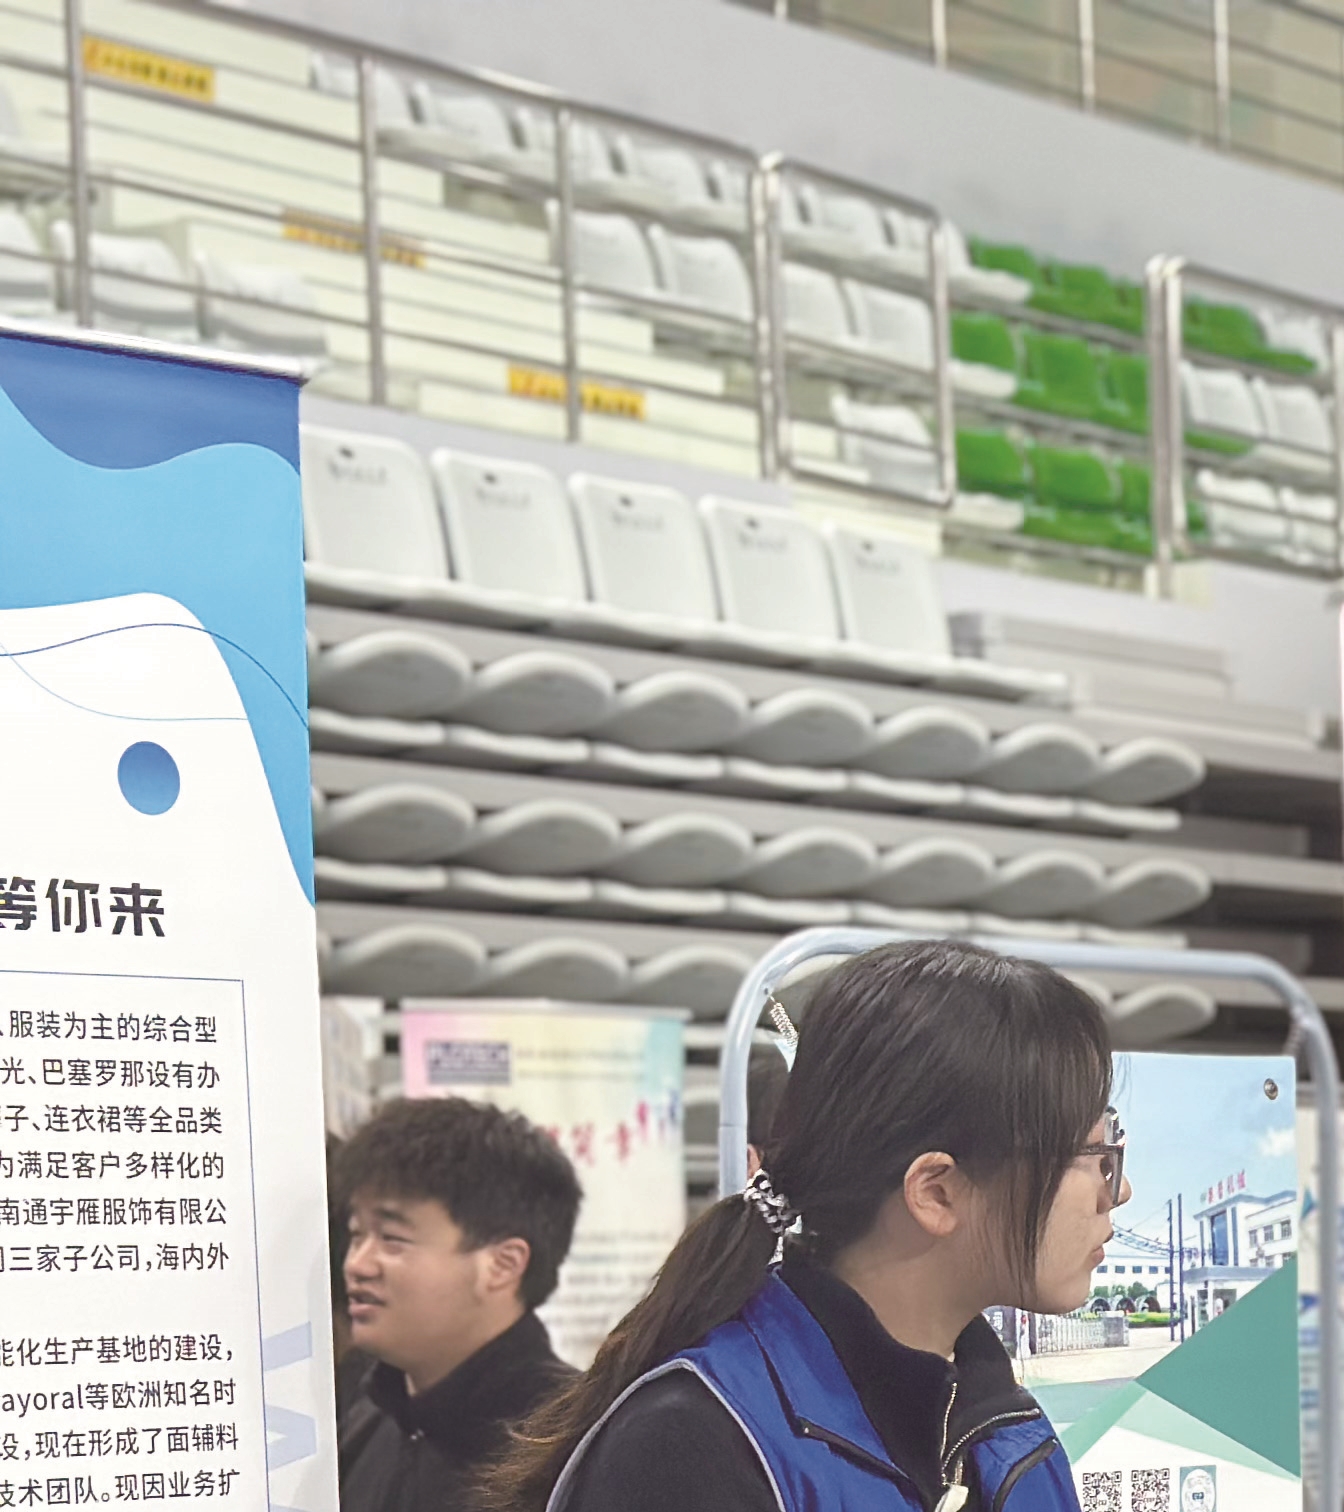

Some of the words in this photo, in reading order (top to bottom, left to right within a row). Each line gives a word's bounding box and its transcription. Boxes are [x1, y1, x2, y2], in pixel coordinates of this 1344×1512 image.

[0, 876, 165, 938] 等你来
[0, 1056, 220, 1089] 光、巴塞罗那设有办
[0, 1104, 223, 1134] 子、连衣裙等全品类
[0, 1197, 227, 1226] 南通宇雁服饰有限公
[0, 1242, 229, 1272] 三家子公司，海内外
